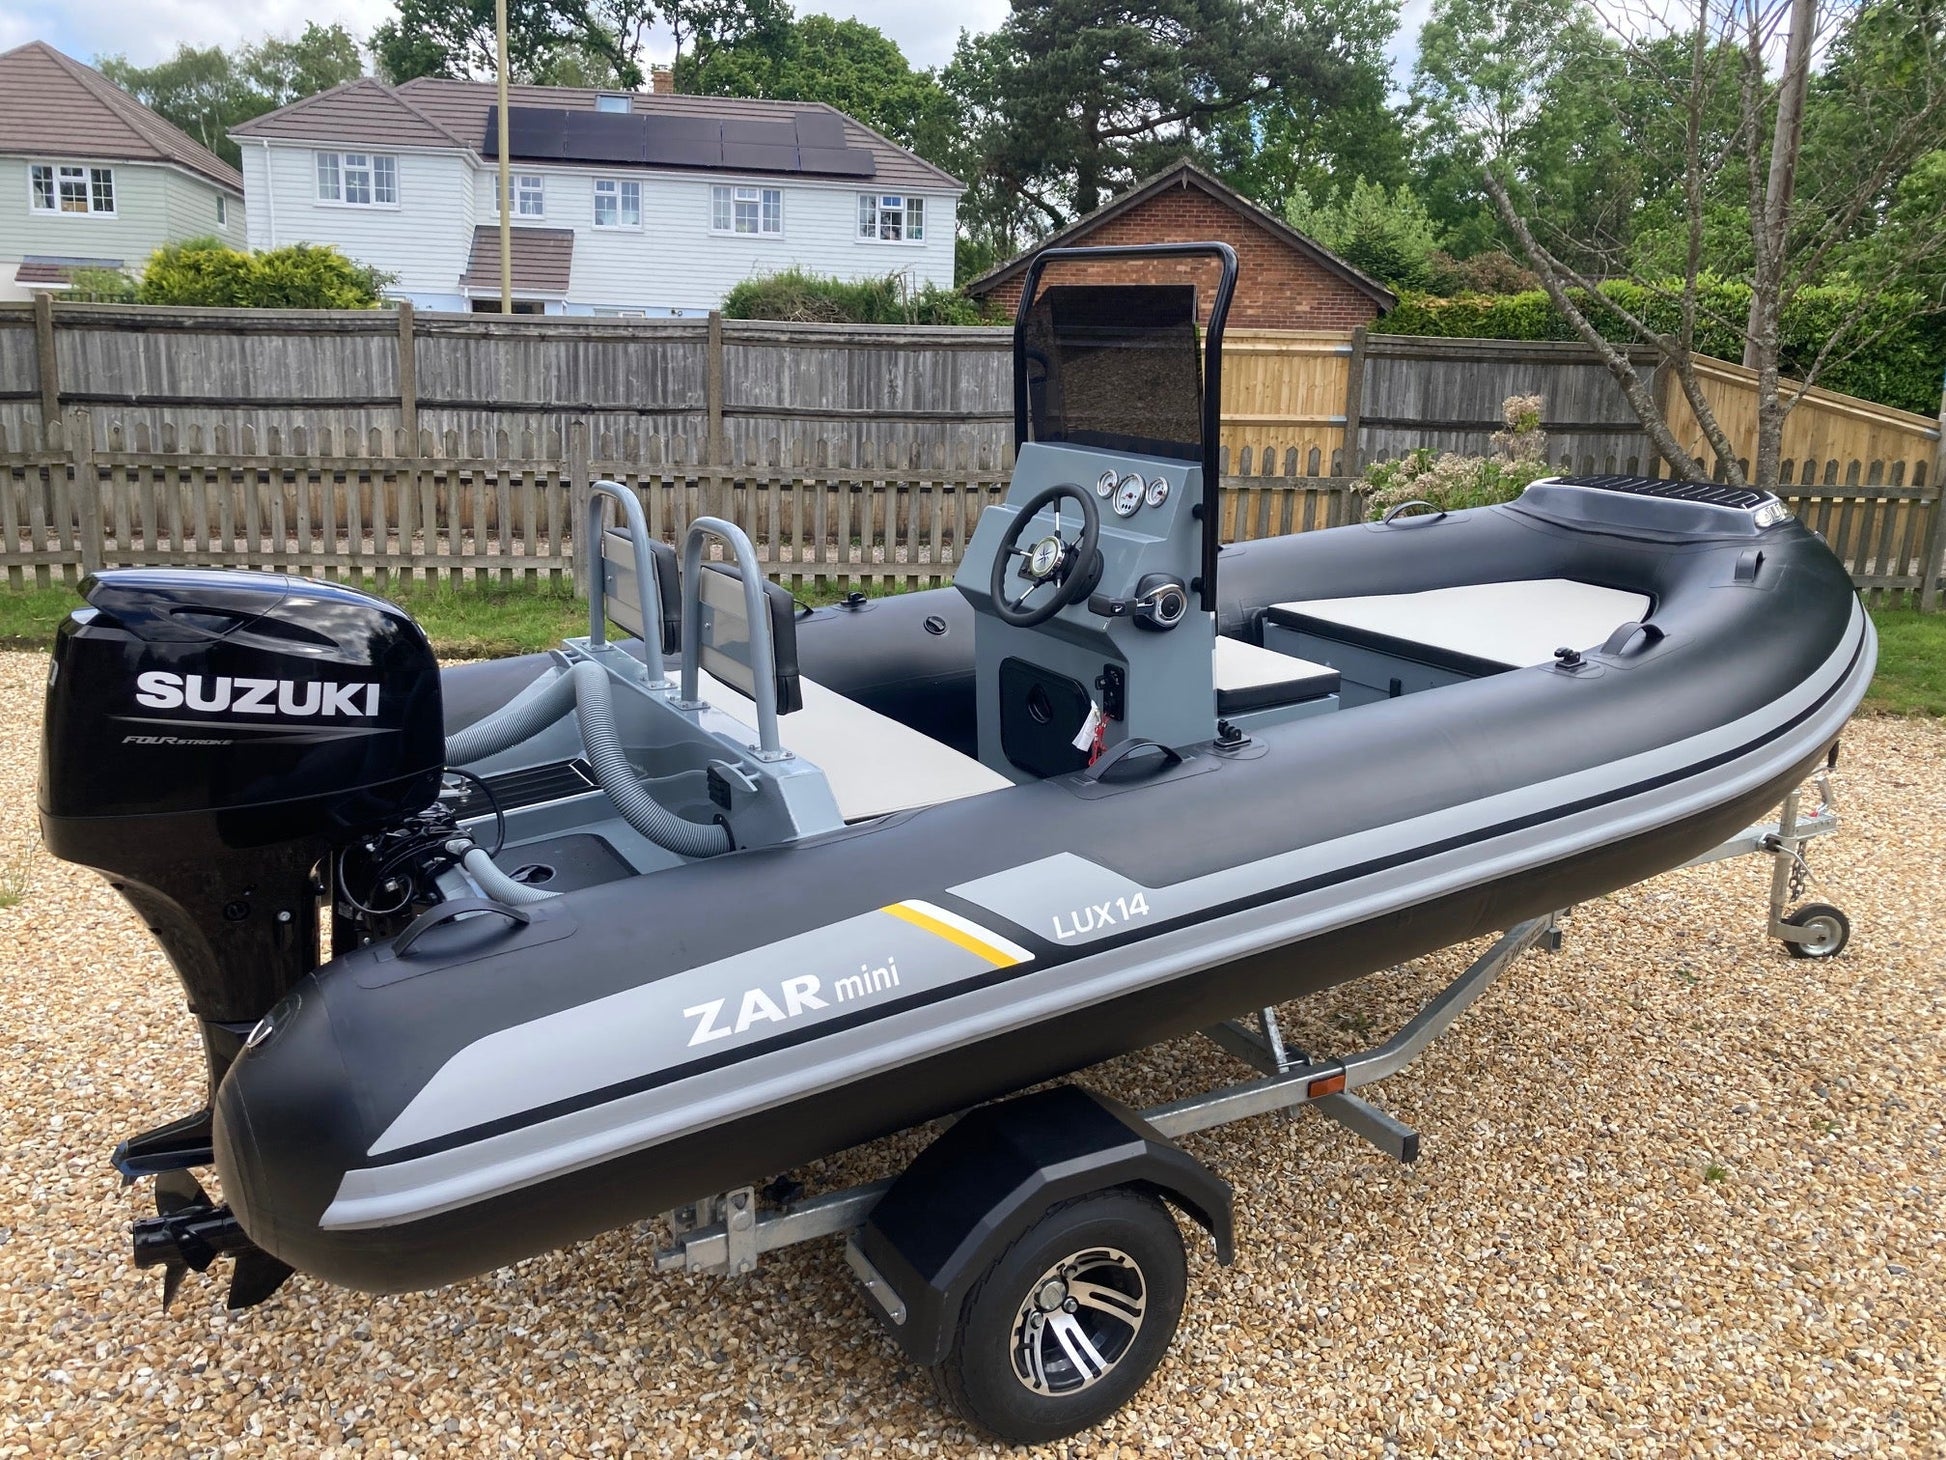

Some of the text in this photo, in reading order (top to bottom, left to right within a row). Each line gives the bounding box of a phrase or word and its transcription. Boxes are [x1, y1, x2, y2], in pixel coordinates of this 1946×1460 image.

[136, 671, 380, 717] SUZUKI
[682, 956, 901, 1048] ZAR mini
